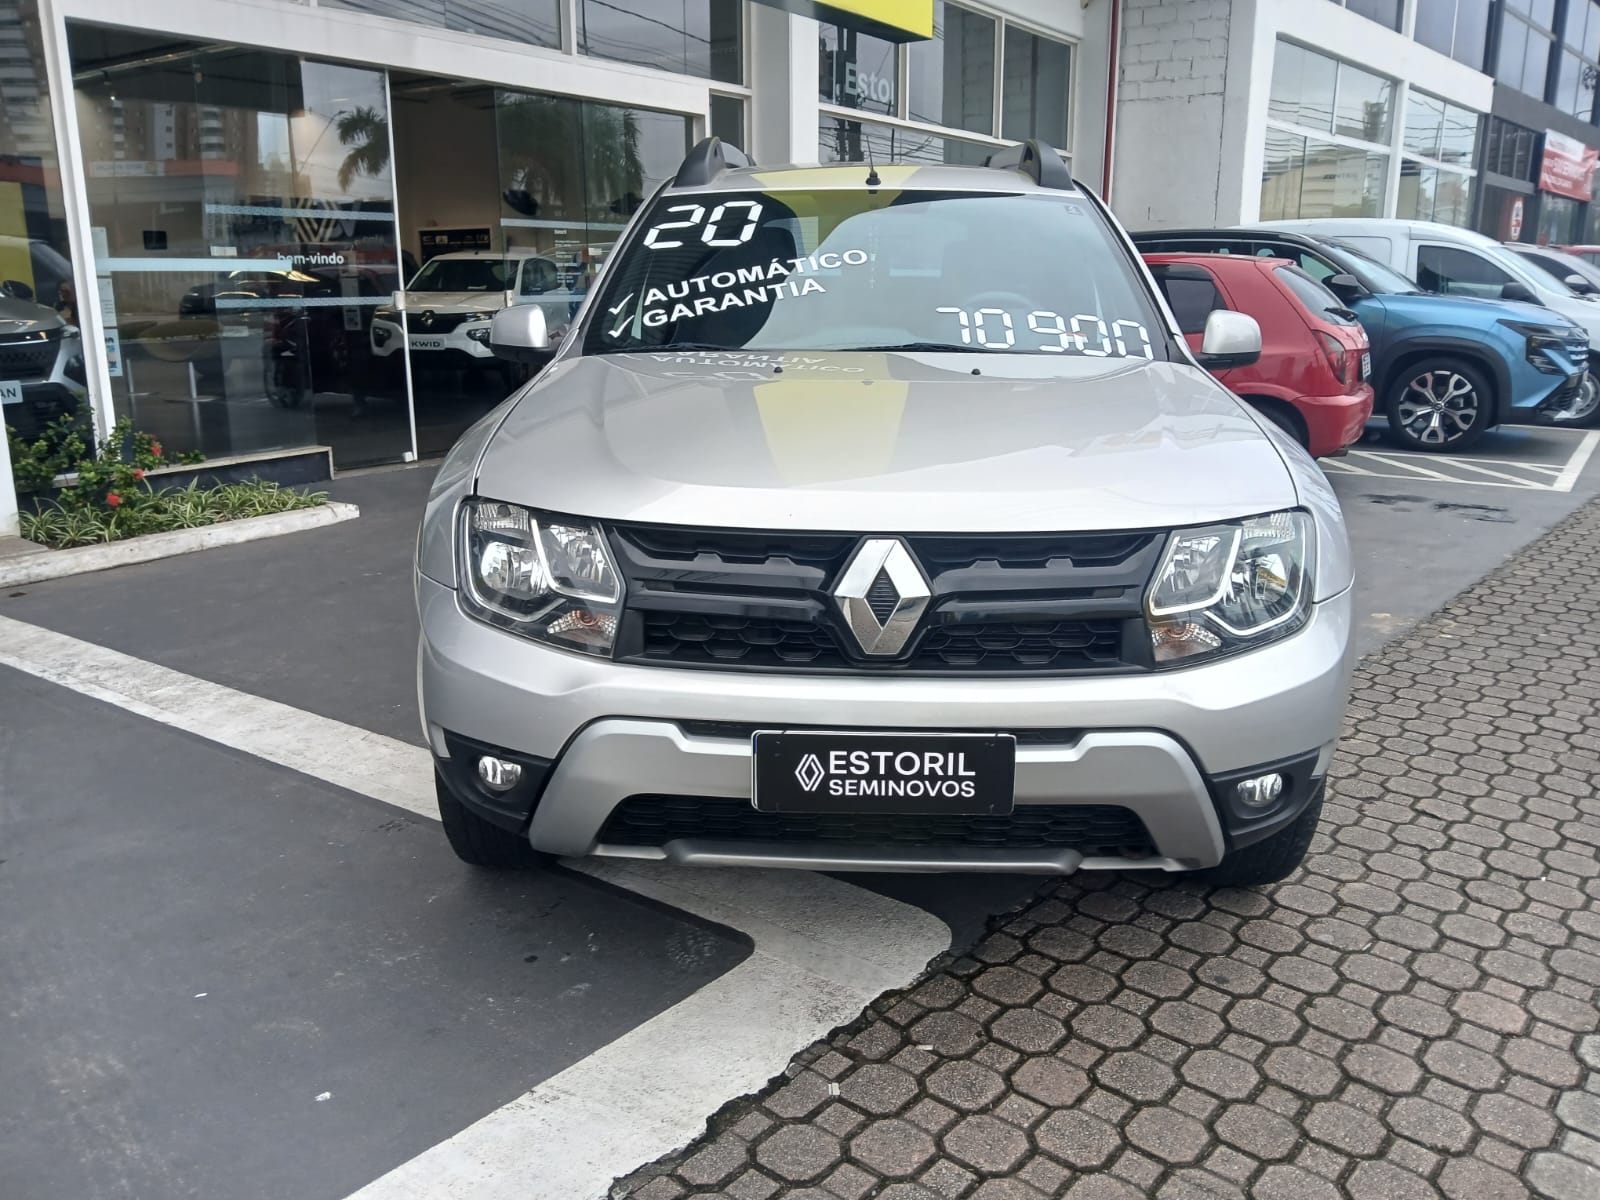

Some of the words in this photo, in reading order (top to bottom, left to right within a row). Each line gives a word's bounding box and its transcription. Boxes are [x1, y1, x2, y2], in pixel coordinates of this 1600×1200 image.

[643, 200, 763, 249] 20
[644, 249, 868, 305] AUTOMÁTICO
[642, 278, 826, 327] GARANTIA
[829, 751, 976, 776] ESTORIL
[829, 779, 976, 798] SEMINOVOS
